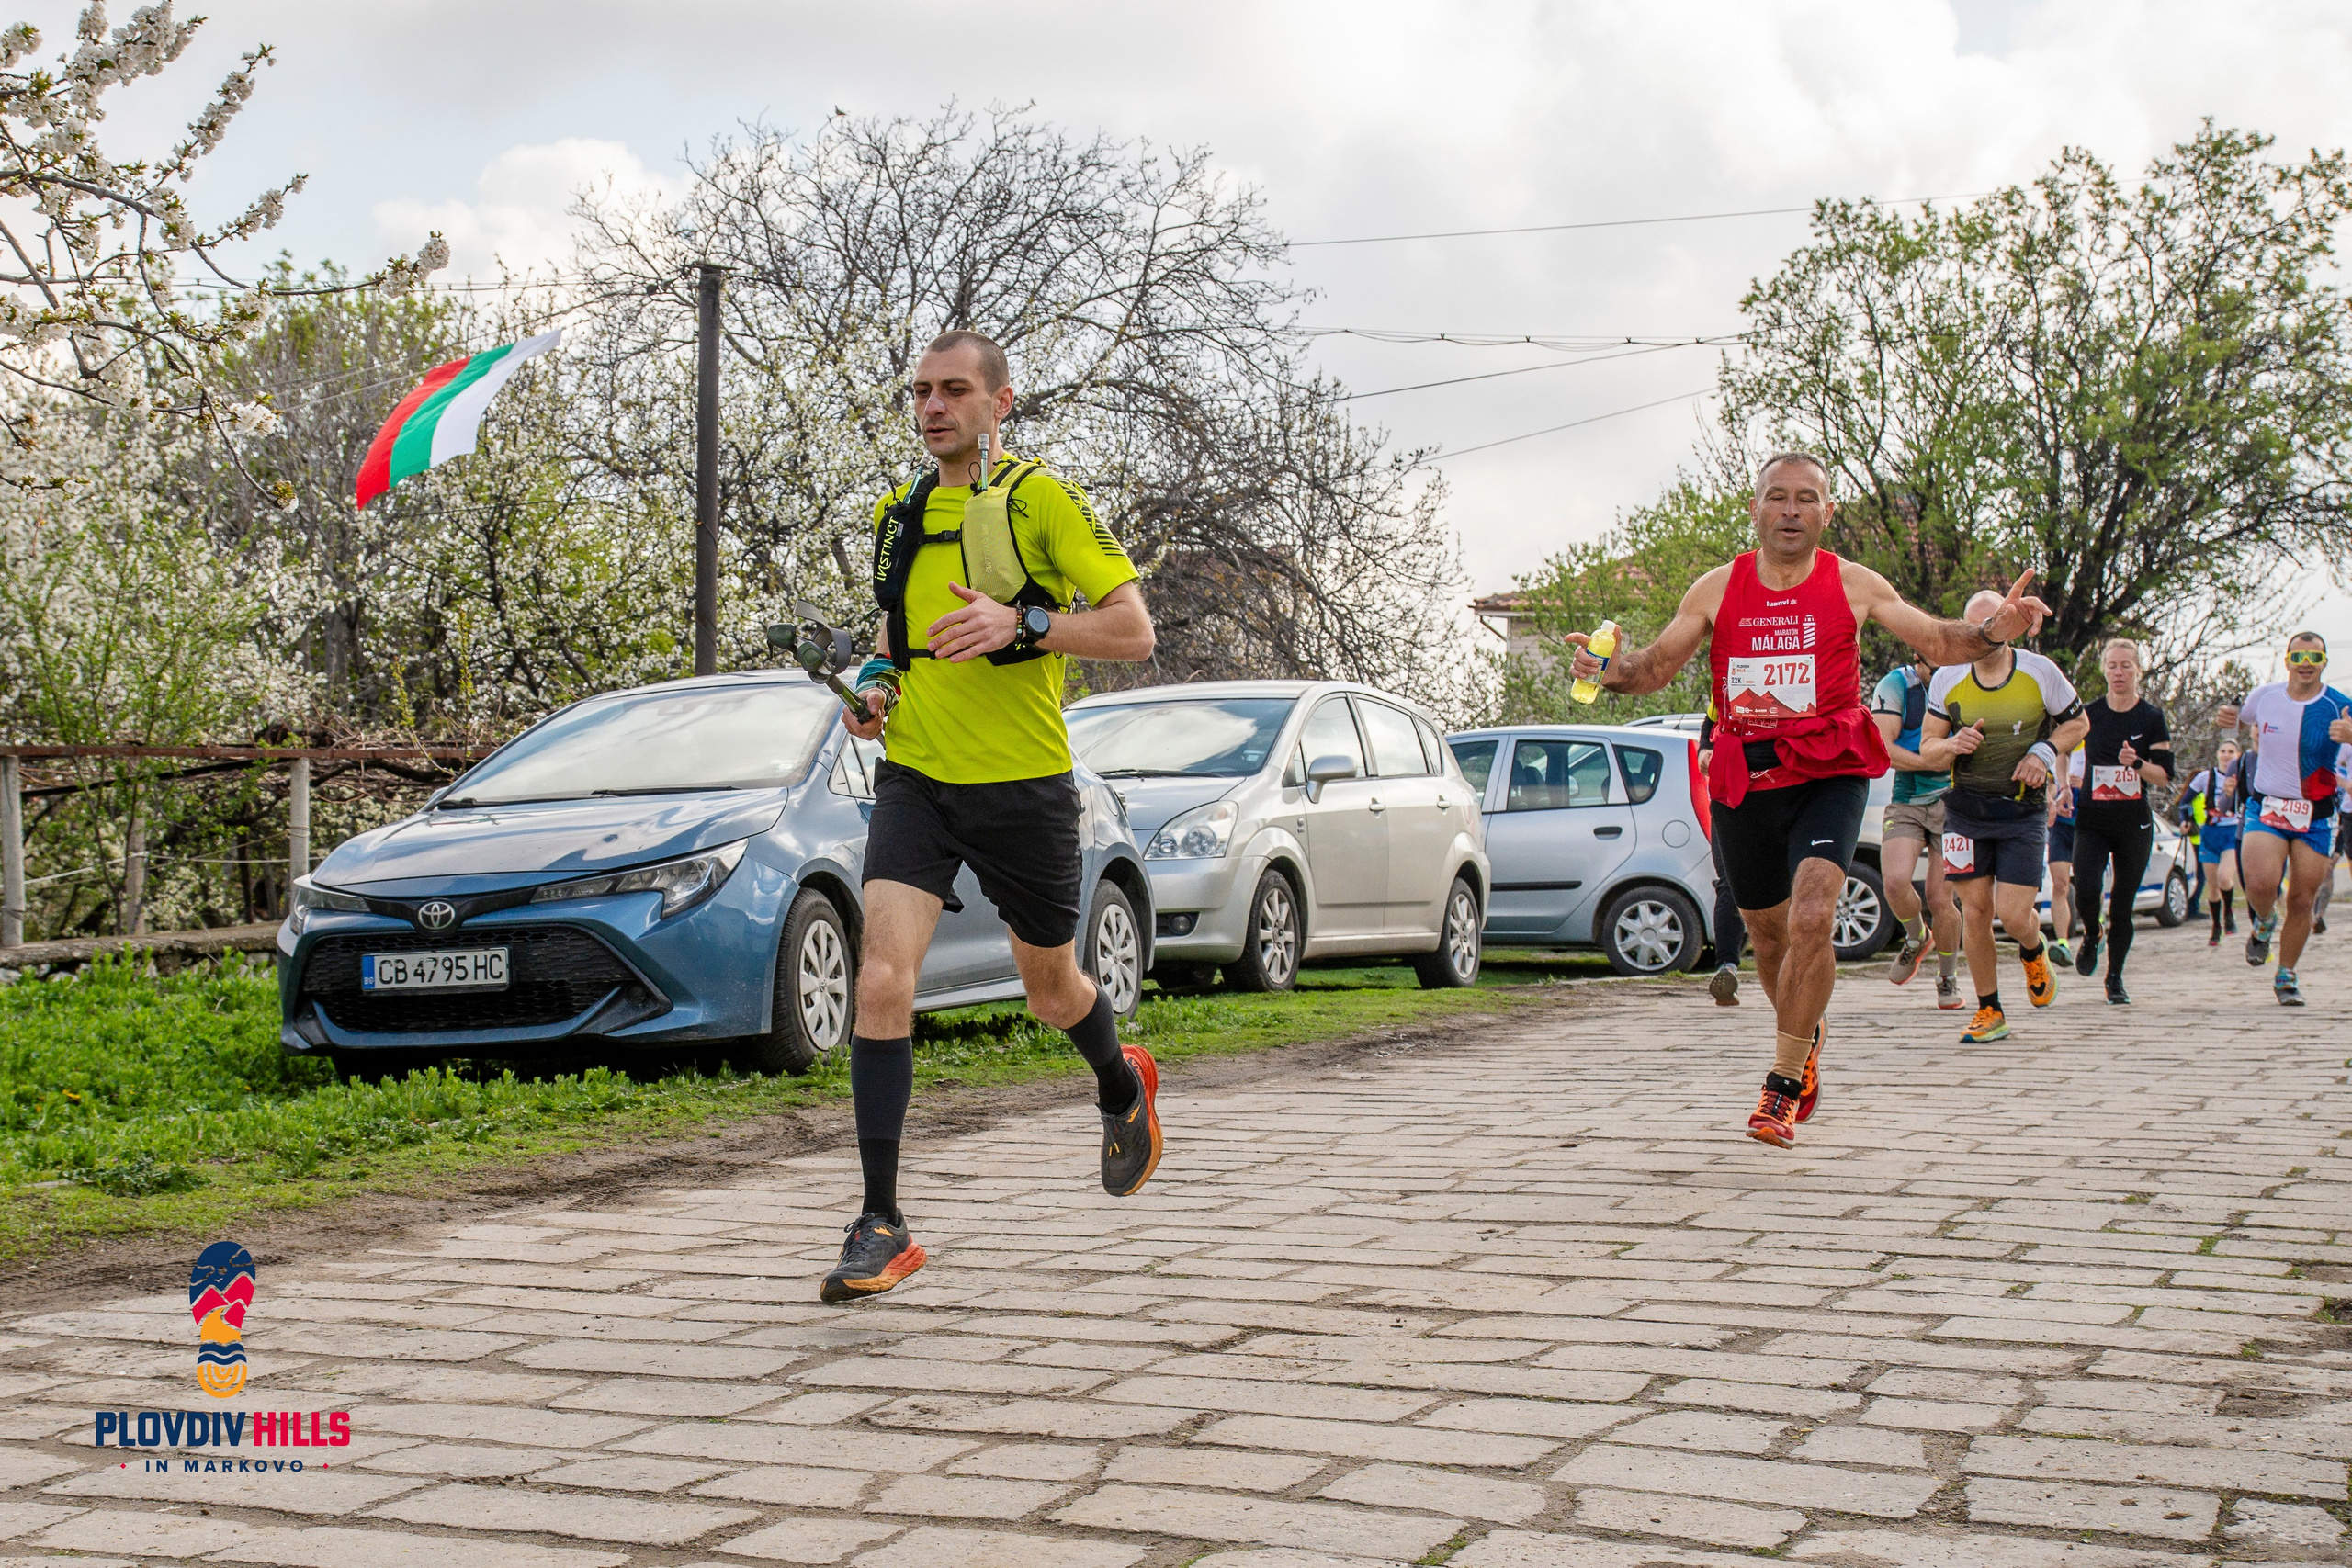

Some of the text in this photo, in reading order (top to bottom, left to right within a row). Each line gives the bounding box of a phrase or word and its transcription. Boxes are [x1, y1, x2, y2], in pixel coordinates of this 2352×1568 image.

[1752, 615, 1799, 626] GENERALI
[1751, 634, 1800, 651] MÁLAGA
[1764, 662, 1811, 686] 2172
[2281, 798, 2310, 815] 2199
[1944, 837, 1970, 852] 2421
[379, 953, 503, 985] CB 4795 HC
[364, 976, 374, 985] BG
